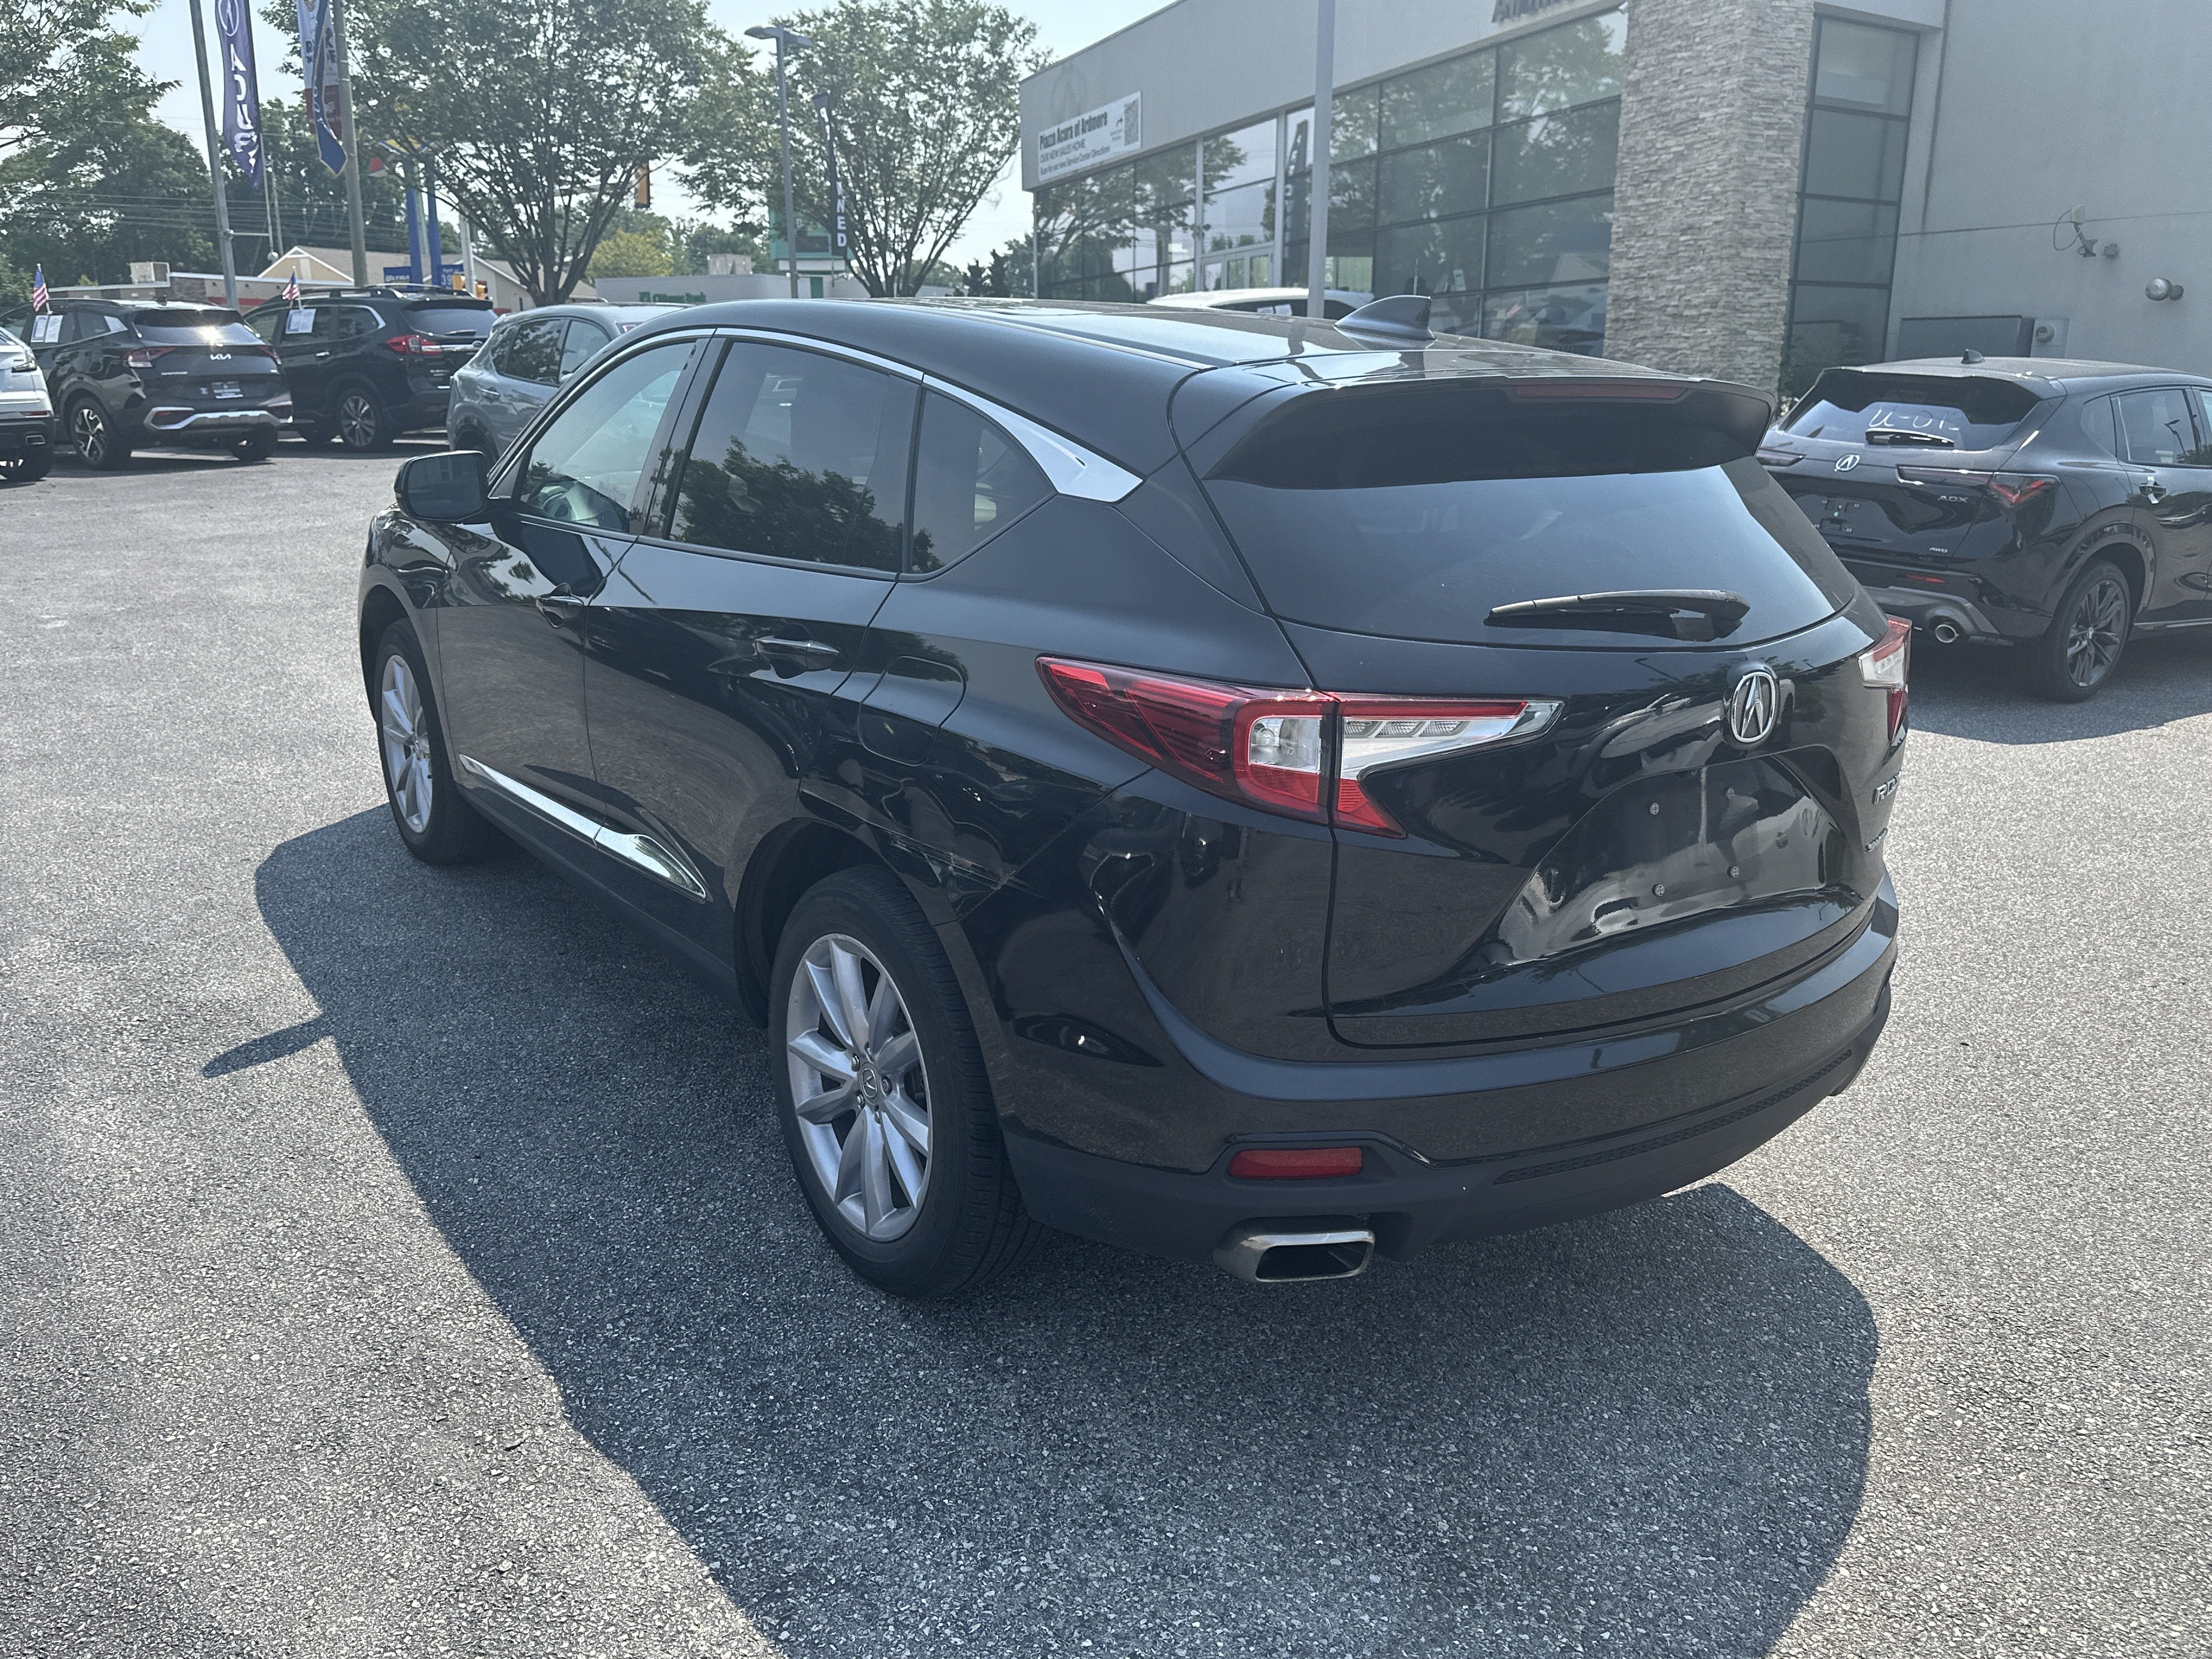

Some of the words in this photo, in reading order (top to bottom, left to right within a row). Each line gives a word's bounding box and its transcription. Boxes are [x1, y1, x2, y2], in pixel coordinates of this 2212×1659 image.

[1040, 133, 1056, 150] Piazza
[1057, 126, 1073, 145] Acura
[1075, 120, 1080, 137] of
[1081, 112, 1108, 135] Ardmore
